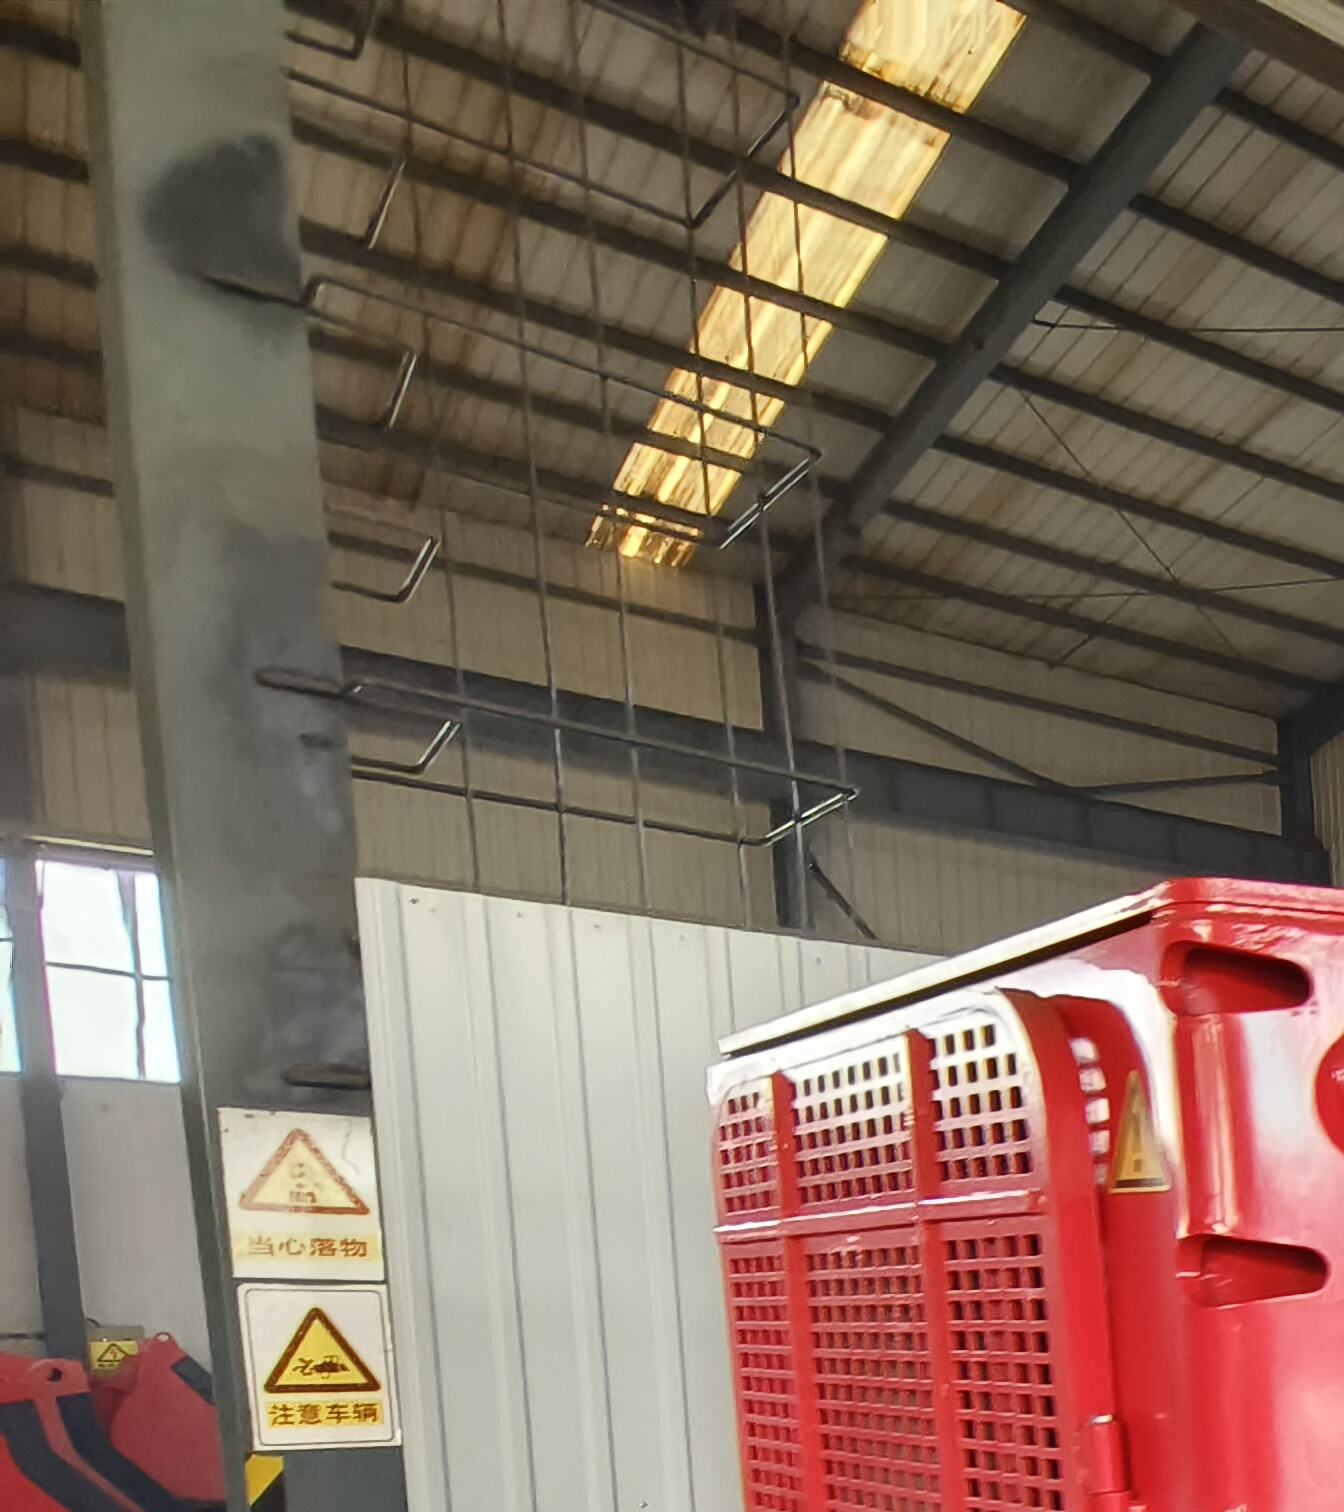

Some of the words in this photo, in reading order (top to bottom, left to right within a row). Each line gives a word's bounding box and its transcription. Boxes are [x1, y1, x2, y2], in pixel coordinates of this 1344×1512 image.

[248, 1236, 368, 1257] 当心落物
[268, 1403, 378, 1426] 注意车辆
